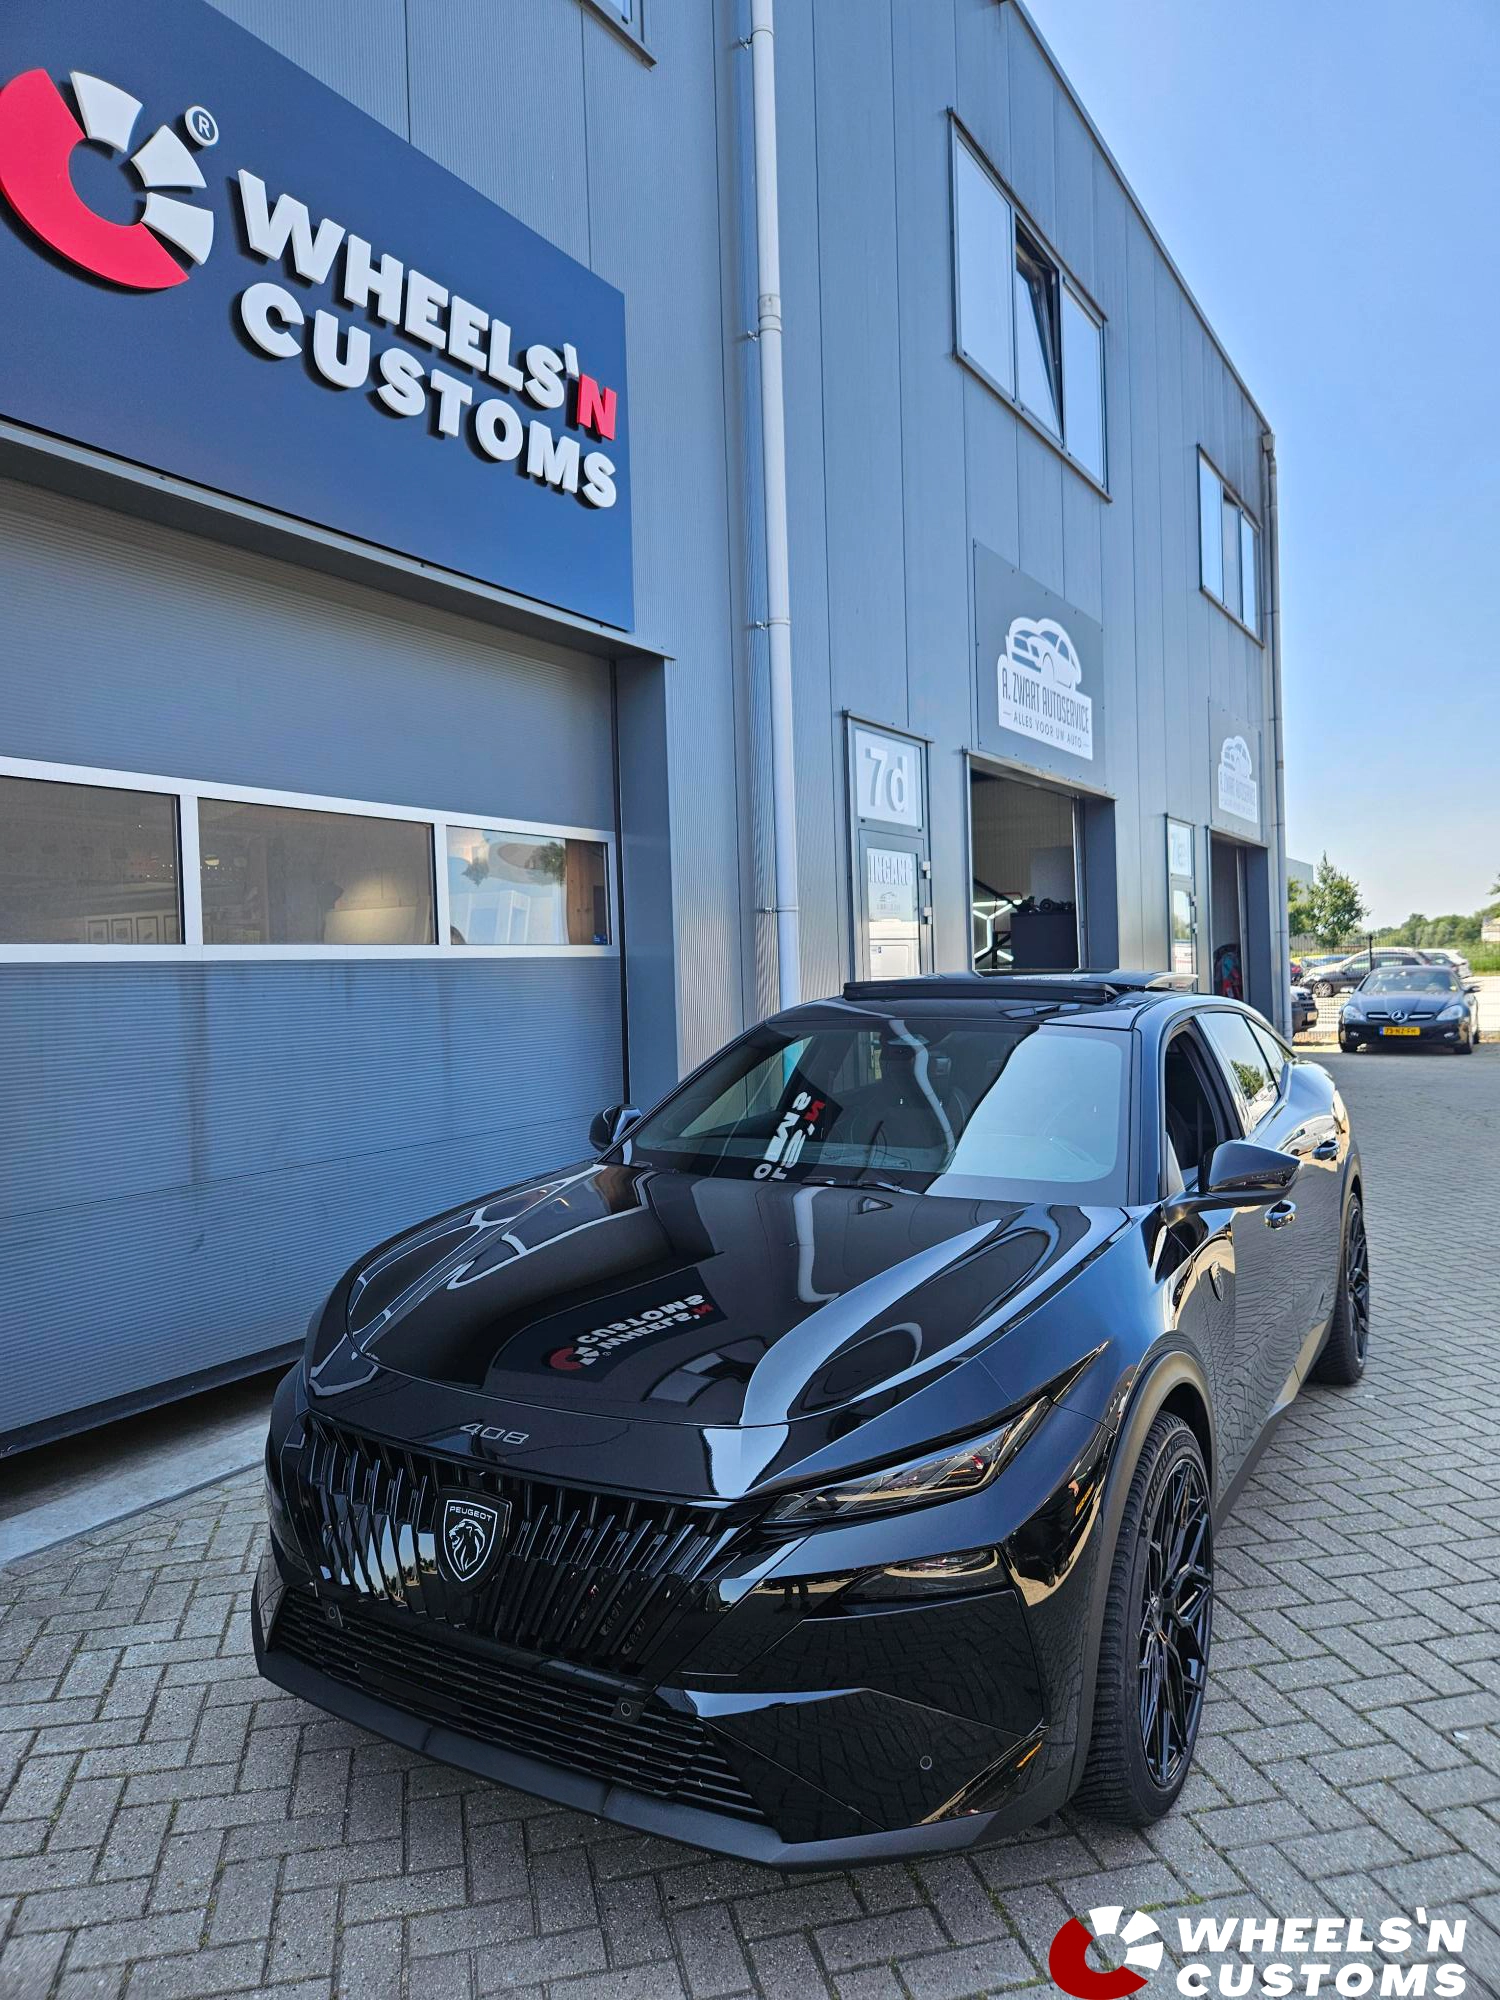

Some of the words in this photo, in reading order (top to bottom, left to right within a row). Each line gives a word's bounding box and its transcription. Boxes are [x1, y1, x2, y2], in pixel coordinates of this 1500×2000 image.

[238, 169, 617, 441] WHEELS'N
[241, 282, 617, 508] CUSTOMS
[1001, 667, 1011, 701] A.
[1013, 671, 1040, 713] ZWART
[1042, 686, 1089, 735] AUTOSERVICE
[1013, 711, 1033, 729] ALLES
[1035, 719, 1054, 738] VOOR
[1067, 733, 1082, 749] AUTO
[866, 747, 908, 813] 7d
[459, 1423, 530, 1445] 408
[449, 1505, 493, 1523] PEUGEOT
